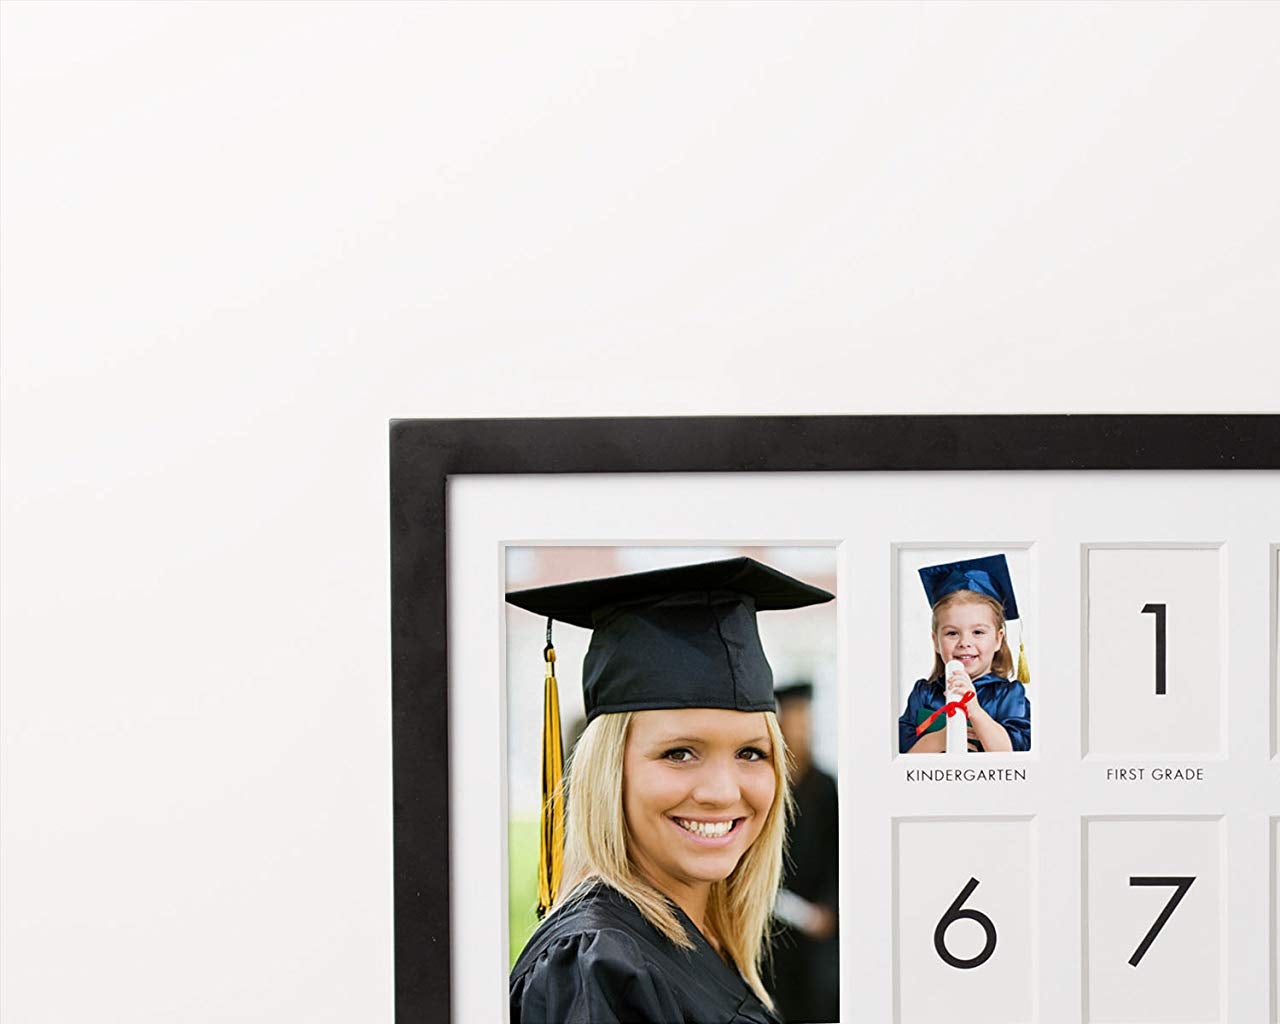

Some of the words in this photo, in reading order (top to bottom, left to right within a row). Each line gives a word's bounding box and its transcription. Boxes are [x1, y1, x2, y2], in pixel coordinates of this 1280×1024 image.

[1140, 603, 1167, 695] 1
[906, 768, 1026, 782] KINDERGARTEN
[1106, 768, 1145, 781] FIRST
[1151, 768, 1203, 781] GRADE
[933, 876, 998, 970] 6
[1127, 876, 1197, 968] 7
